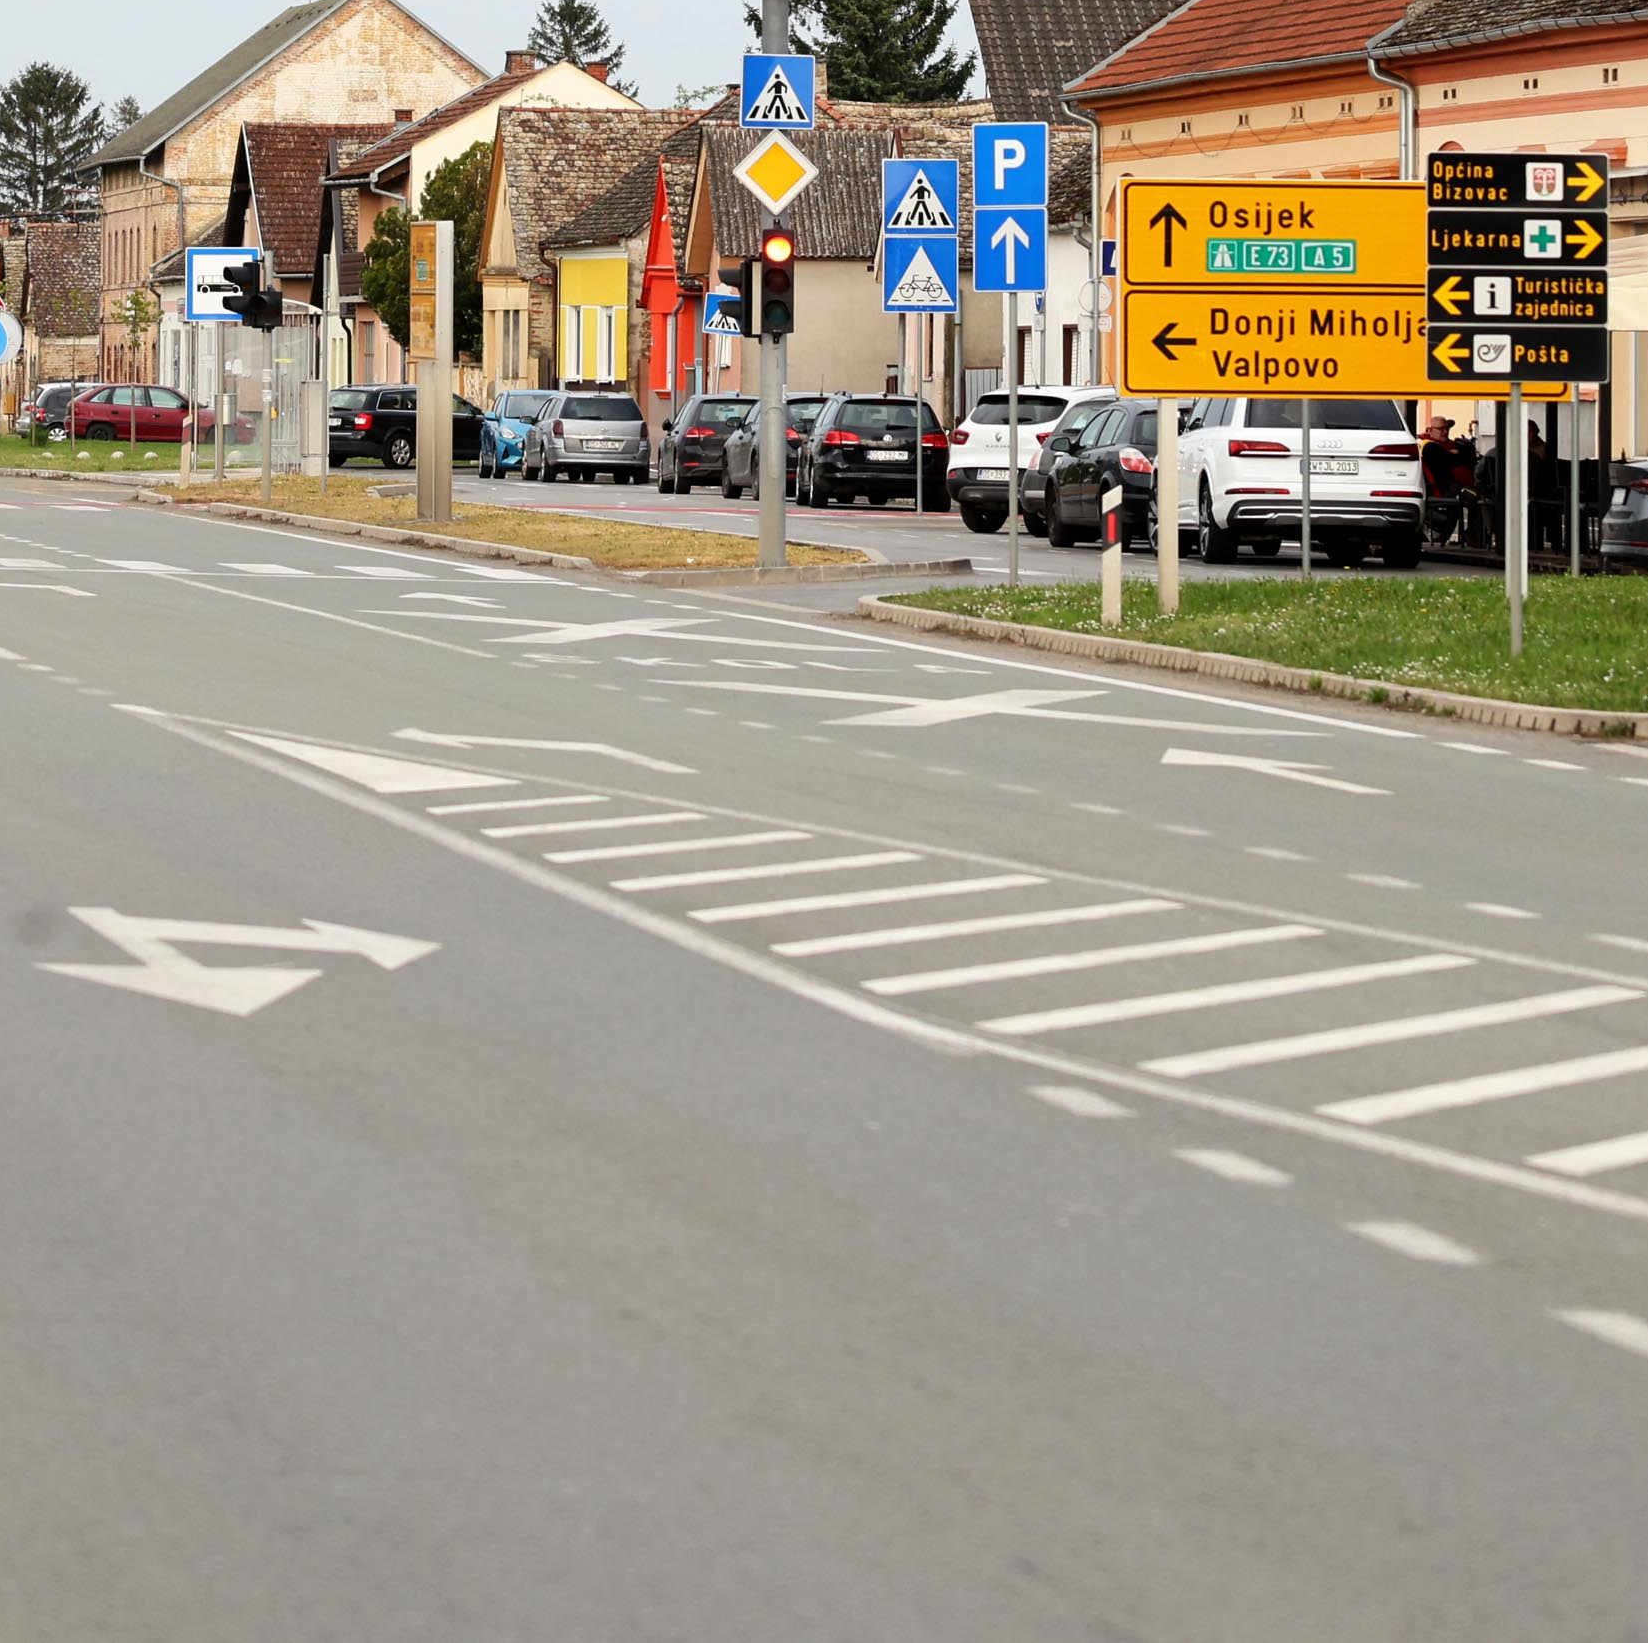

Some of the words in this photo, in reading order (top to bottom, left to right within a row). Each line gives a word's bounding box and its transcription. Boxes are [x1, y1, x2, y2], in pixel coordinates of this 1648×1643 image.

[994, 139, 1026, 190] P
[1433, 161, 1494, 181] Općina
[1433, 183, 1508, 200] Bizovac
[1209, 200, 1315, 236] Osijek
[1431, 229, 1521, 252] Ljekarna
[1251, 246, 1261, 266] E
[1267, 246, 1289, 266] 73
[1313, 247, 1325, 266] A
[1332, 247, 1344, 266] 5
[1514, 276, 1604, 295] Turistička
[1515, 300, 1594, 320] zajednica
[1210, 308, 1295, 343] Donji
[1310, 308, 1427, 344] Miholja
[1514, 345, 1569, 363] Pošta
[1212, 350, 1339, 385] Valpovo
[1337, 462, 1357, 472] 2013
